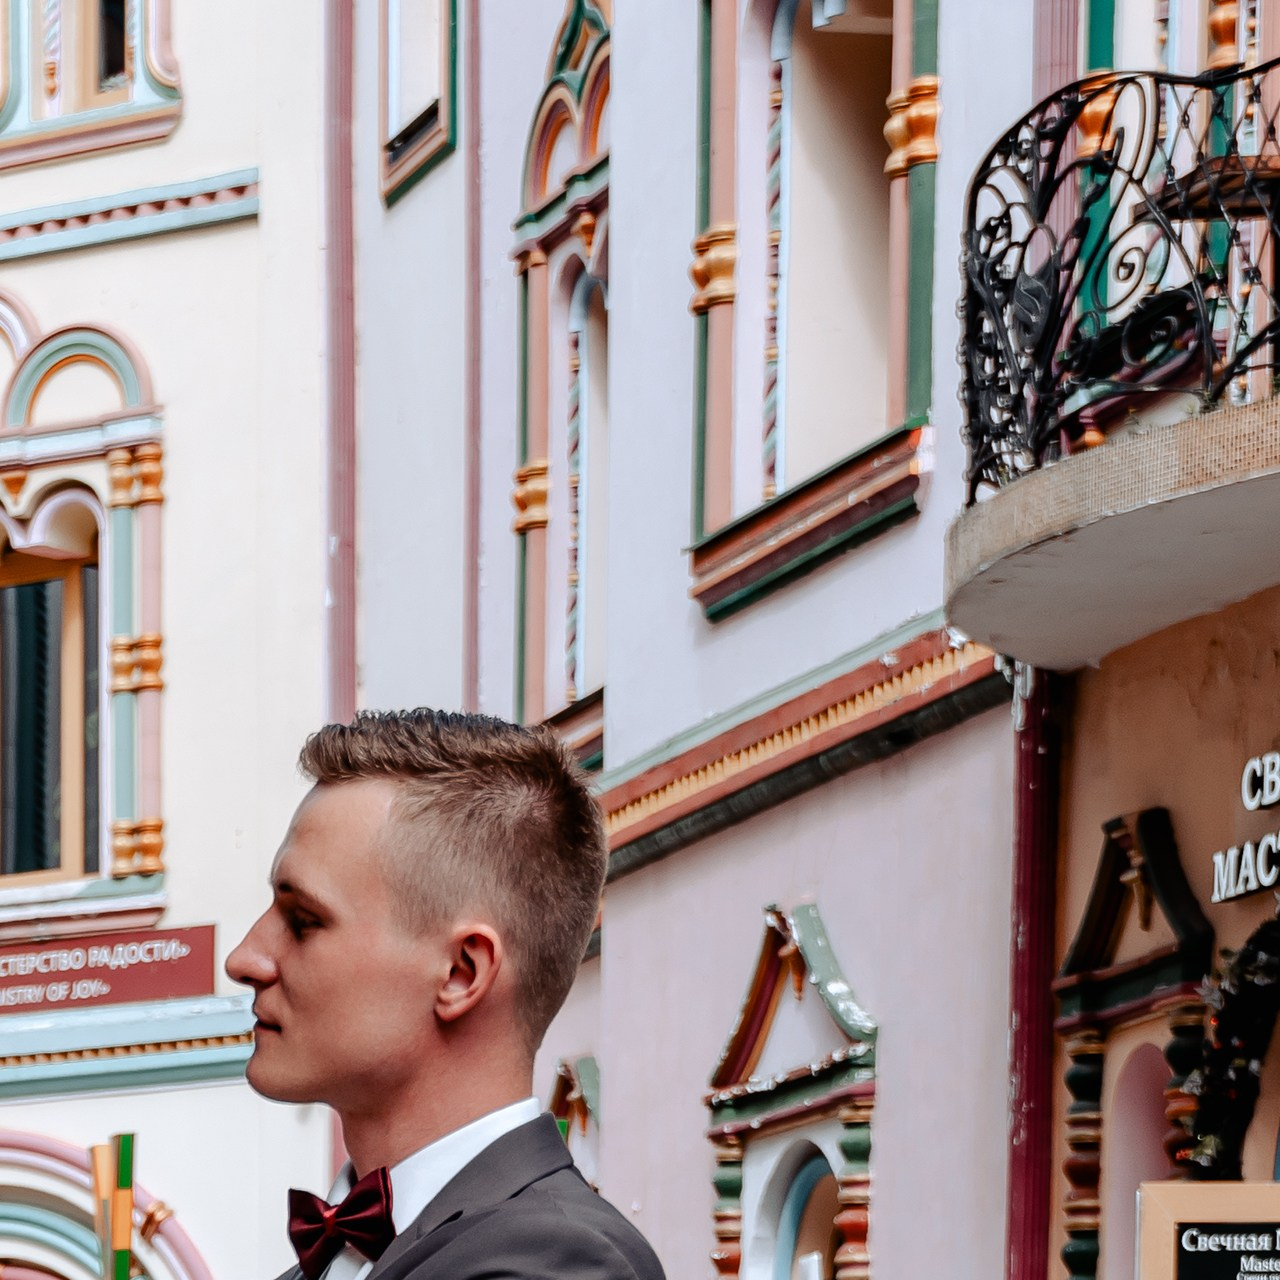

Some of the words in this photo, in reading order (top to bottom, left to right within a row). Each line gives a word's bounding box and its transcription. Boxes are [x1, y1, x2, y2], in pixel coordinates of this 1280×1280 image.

[1211, 829, 1280, 903] МАС
[88, 939, 191, 969] РАДОСТИ»
[46, 982, 70, 1001] OF
[70, 979, 111, 1000] JOY»
[1181, 1228, 1272, 1251] Свечная
